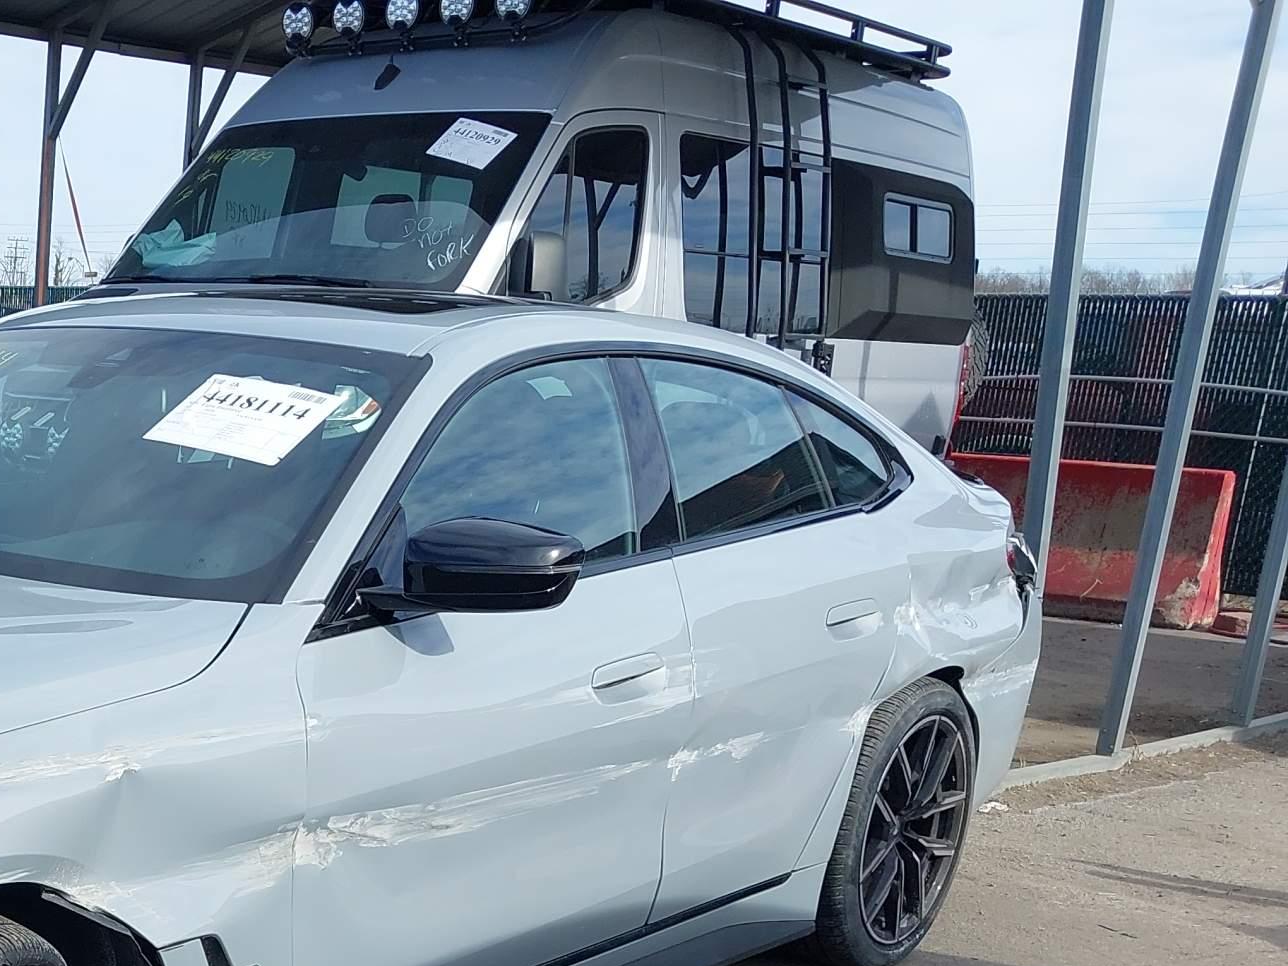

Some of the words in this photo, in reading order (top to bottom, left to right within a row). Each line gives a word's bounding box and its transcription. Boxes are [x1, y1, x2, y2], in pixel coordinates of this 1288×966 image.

[453, 127, 501, 146] 44120929
[400, 216, 434, 238] DO
[203, 390, 312, 420] 44181114
